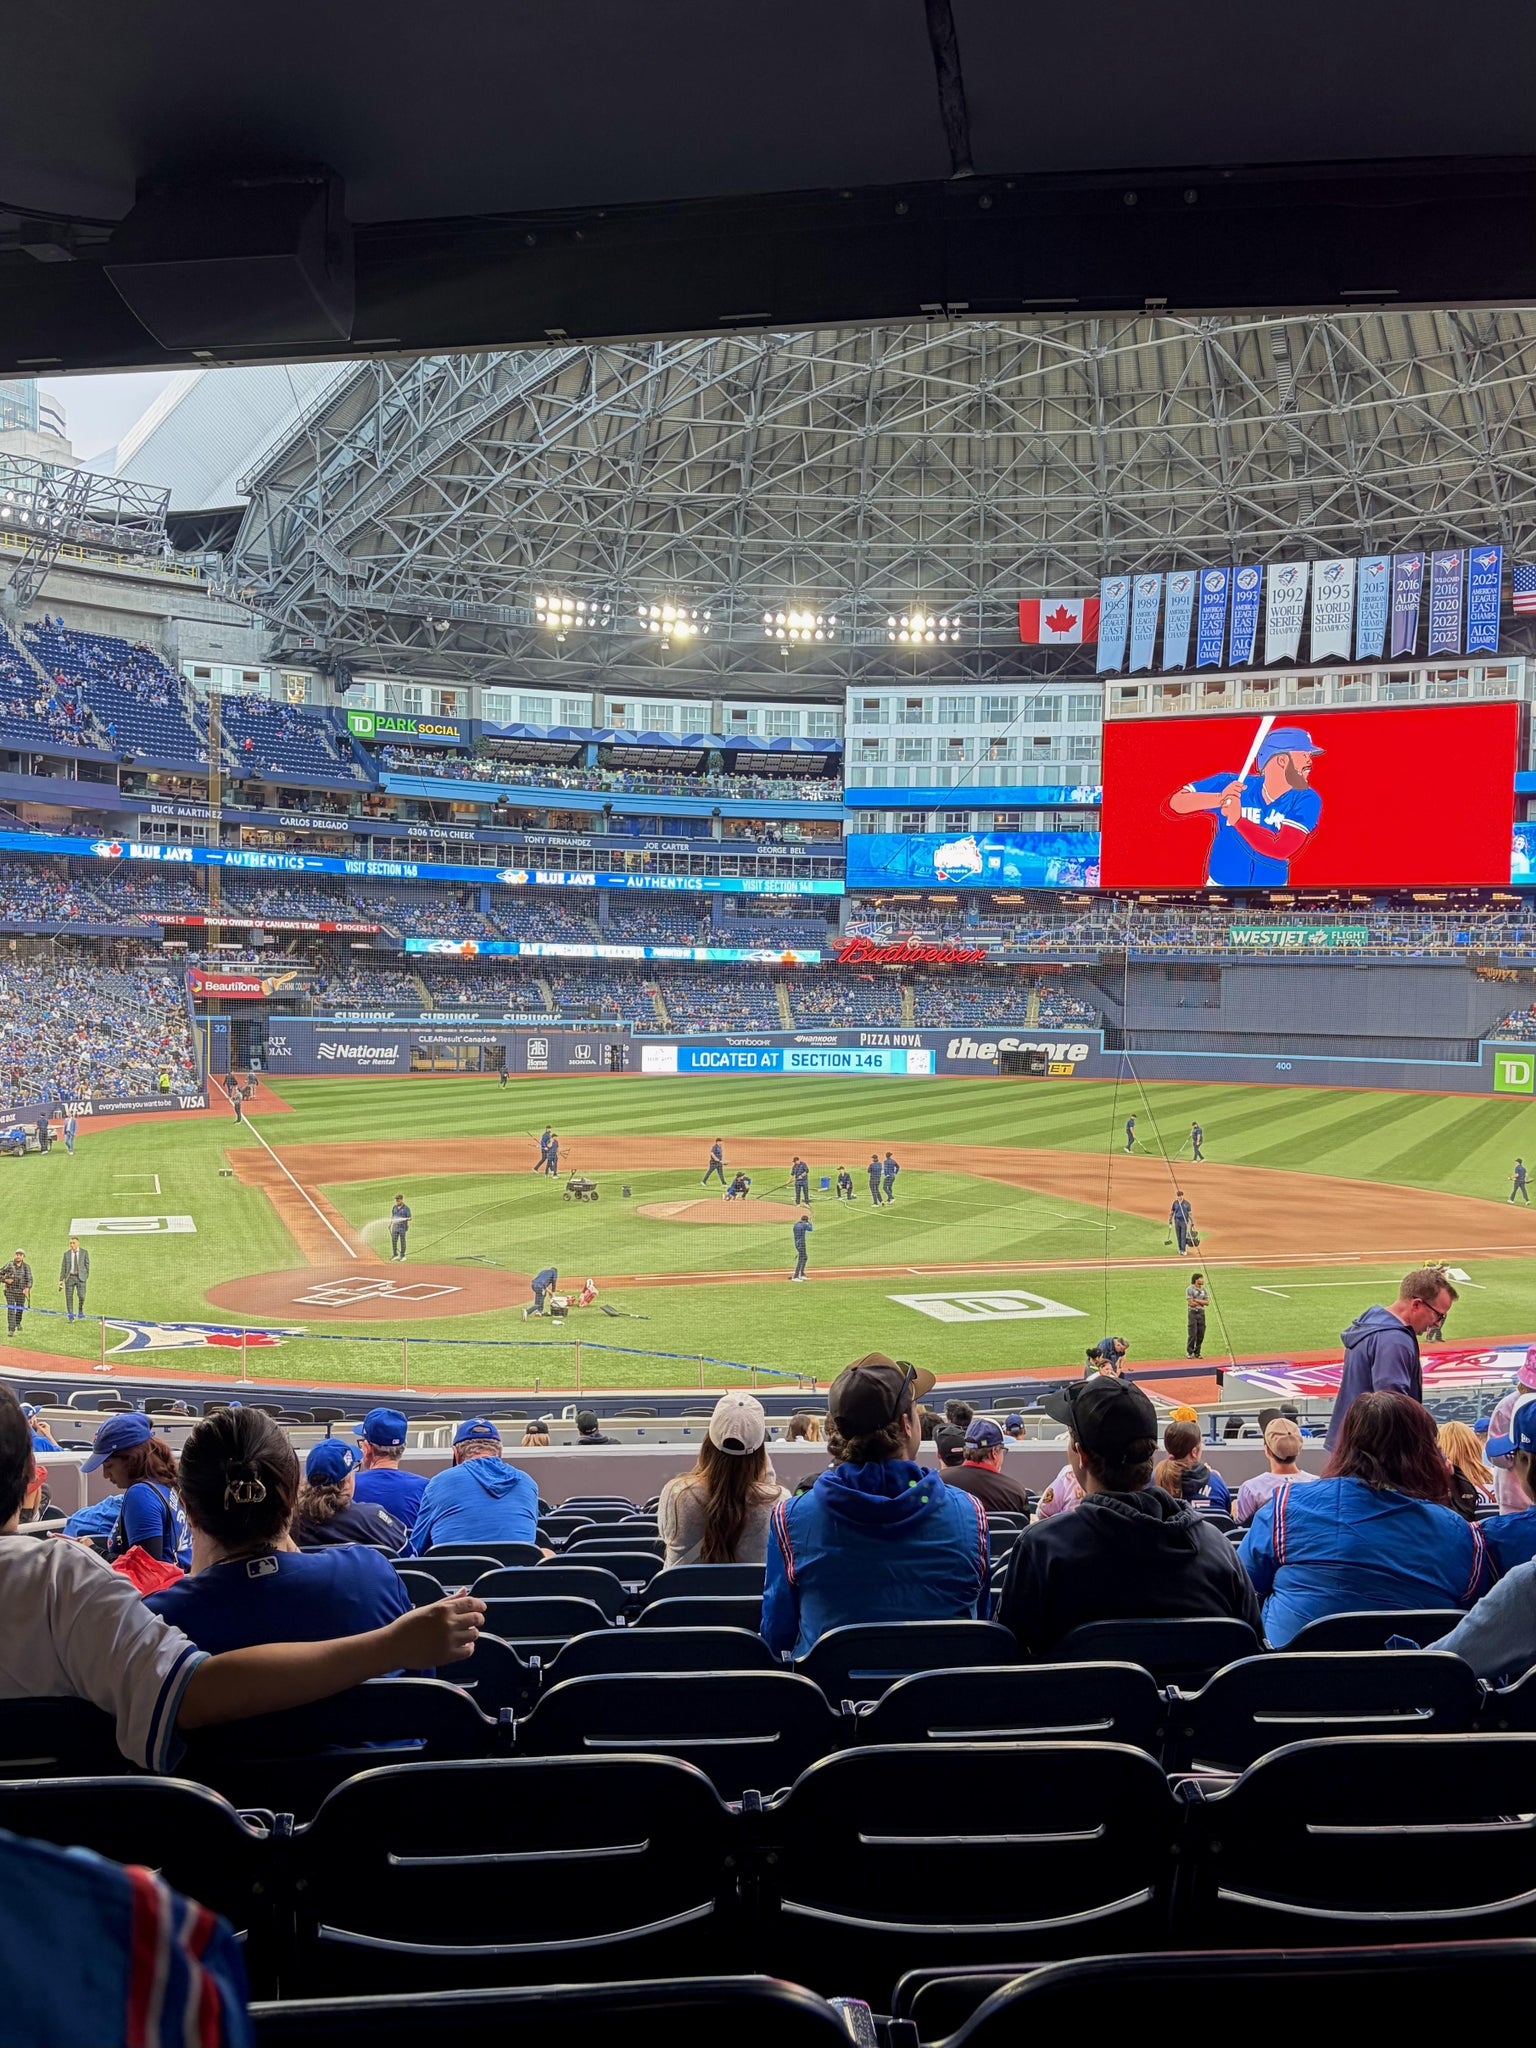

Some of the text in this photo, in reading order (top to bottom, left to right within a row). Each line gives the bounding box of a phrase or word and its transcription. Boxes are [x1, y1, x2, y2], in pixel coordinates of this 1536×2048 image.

[1397, 579, 1420, 591] 2016
[1472, 574, 1497, 585] 2025
[1318, 584, 1350, 601] 1993
[1363, 582, 1385, 593] 2015
[1434, 584, 1458, 595] 2016
[1171, 596, 1190, 606] 1991
[1203, 593, 1224, 604] 1992
[1236, 591, 1258, 602] 1993
[1272, 587, 1304, 604] 1992
[1396, 593, 1420, 604] ALDS
[1471, 595, 1497, 603] LEAGUE
[1137, 599, 1158, 609] 1989
[1316, 602, 1351, 614] WORLD
[1361, 602, 1384, 610] LEAGUE
[1395, 604, 1419, 612] CHAMPS
[1433, 599, 1459, 611] 2020
[1471, 603, 1497, 613] EAST
[1271, 606, 1303, 617] WORLD
[1361, 610, 1384, 619] EAST
[1470, 612, 1496, 620] CHAMPS
[1234, 618, 1256, 627] EAST
[1269, 616, 1302, 628] SERIES
[1315, 613, 1350, 625] SERIES
[1361, 619, 1384, 627] CHAMPS
[1432, 615, 1458, 627] 2022
[1201, 620, 1223, 630] EAST
[1315, 624, 1349, 633] CHAMPIONS
[1470, 625, 1496, 636] ALCS
[1102, 627, 1123, 635] EAST
[1361, 631, 1384, 642] ALDS
[1432, 631, 1457, 643] 2023
[1470, 636, 1495, 644] CHAMPS
[1200, 641, 1221, 651] ALC
[1233, 639, 1252, 649] ALC
[350, 716, 460, 736] TD PARK SOCIAL
[151, 804, 223, 819] BUCK MARTINEZ
[280, 817, 349, 831] CARLOS DELGADO
[407, 827, 475, 840] 4306 TOM CHEEK
[523, 835, 592, 847] TONY FERNANDEZ
[644, 841, 690, 851] JOE CARTER
[130, 844, 193, 862] BLUE JAYS
[757, 846, 806, 855] GEORGE BELL
[225, 853, 305, 869] AUTHENTICS
[345, 860, 367, 873] VISIT
[367, 862, 402, 876] SECTION
[535, 872, 596, 885] BLUE JAYS
[627, 876, 703, 889] AUTHENTICS
[742, 880, 763, 891] VISIT
[764, 880, 798, 892] SECTION
[204, 918, 319, 930] PROUD OWNER OF CANADA'S TEAM
[343, 924, 368, 932] ROGERS
[1231, 930, 1366, 946] WESTJET FLIGHT
[832, 936, 986, 964] Budweiser
[205, 981, 260, 992] BeautiTone
[268, 1036, 287, 1047] RLY
[463, 1035, 490, 1043] Canada
[860, 1033, 921, 1047] PIZZA NOVA
[691, 1052, 883, 1068] LOCATED AT SECTION 146
[1049, 1064, 1071, 1074] ET
[1275, 1062, 1292, 1070] 400
[1499, 1060, 1530, 1085] TD
[176, 1095, 205, 1110] VISA
[62, 1101, 94, 1118] VISA
[98, 1101, 131, 1112] everywhere
[131, 1101, 144, 1110] you
[143, 1100, 157, 1108] want
[914, 1296, 1046, 1314] TD
